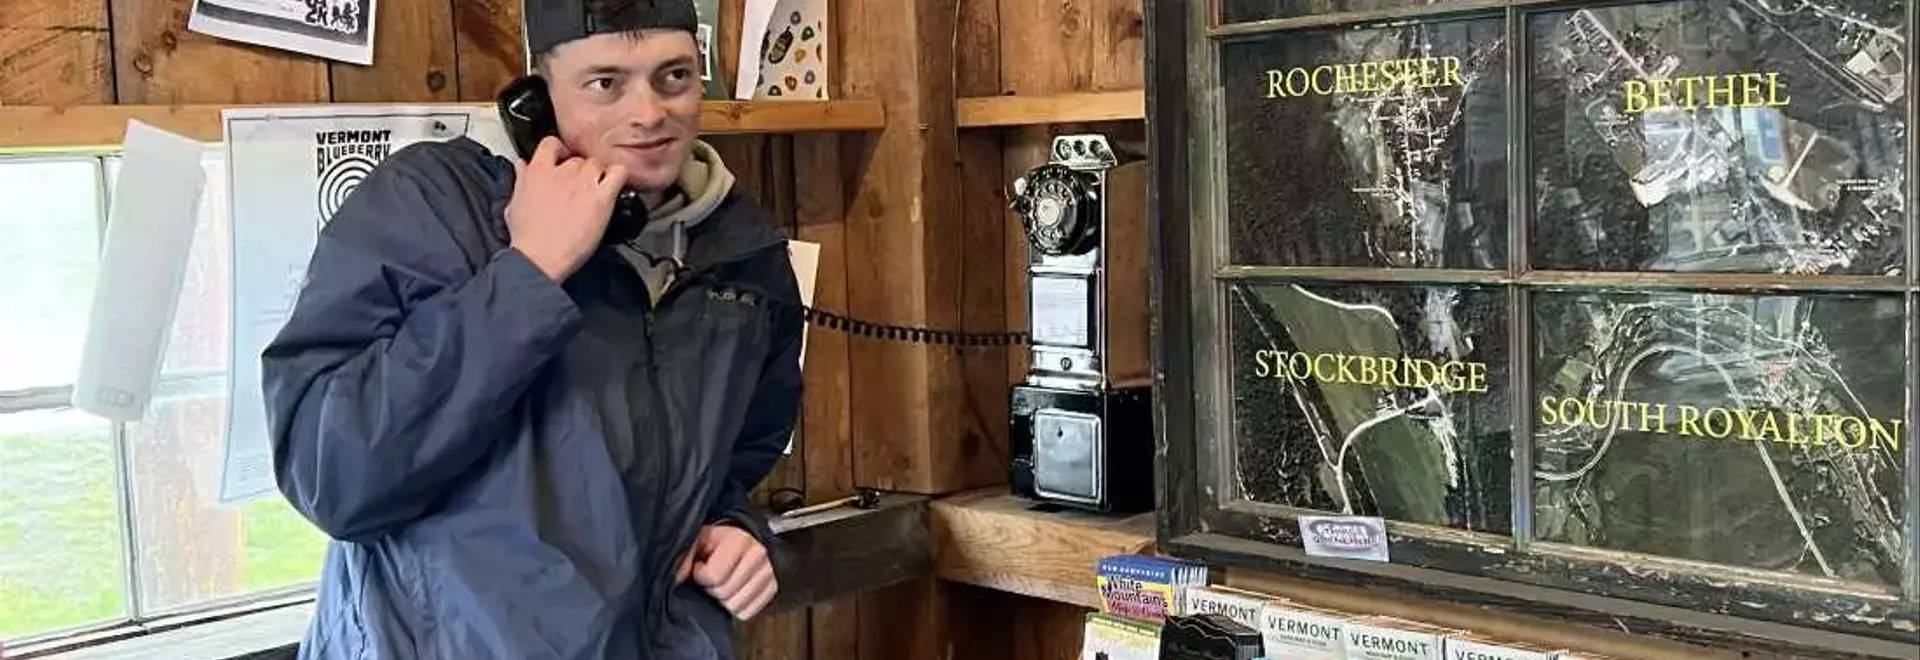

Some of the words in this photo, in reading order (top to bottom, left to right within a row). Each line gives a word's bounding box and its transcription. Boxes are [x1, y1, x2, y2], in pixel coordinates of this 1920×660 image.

[1266, 56, 1465, 98] ROCHESTER
[1624, 72, 1791, 113] BETHEL
[316, 130, 391, 145] VERMONT
[1255, 350, 1488, 392] STOCKBRIDGE
[1541, 396, 1669, 434] SOUTH
[1678, 405, 1901, 450] ROYALTON
[1192, 598, 1256, 621] VERMONT
[1268, 615, 1340, 641] VERMONT
[1351, 634, 1429, 656] VERMONT
